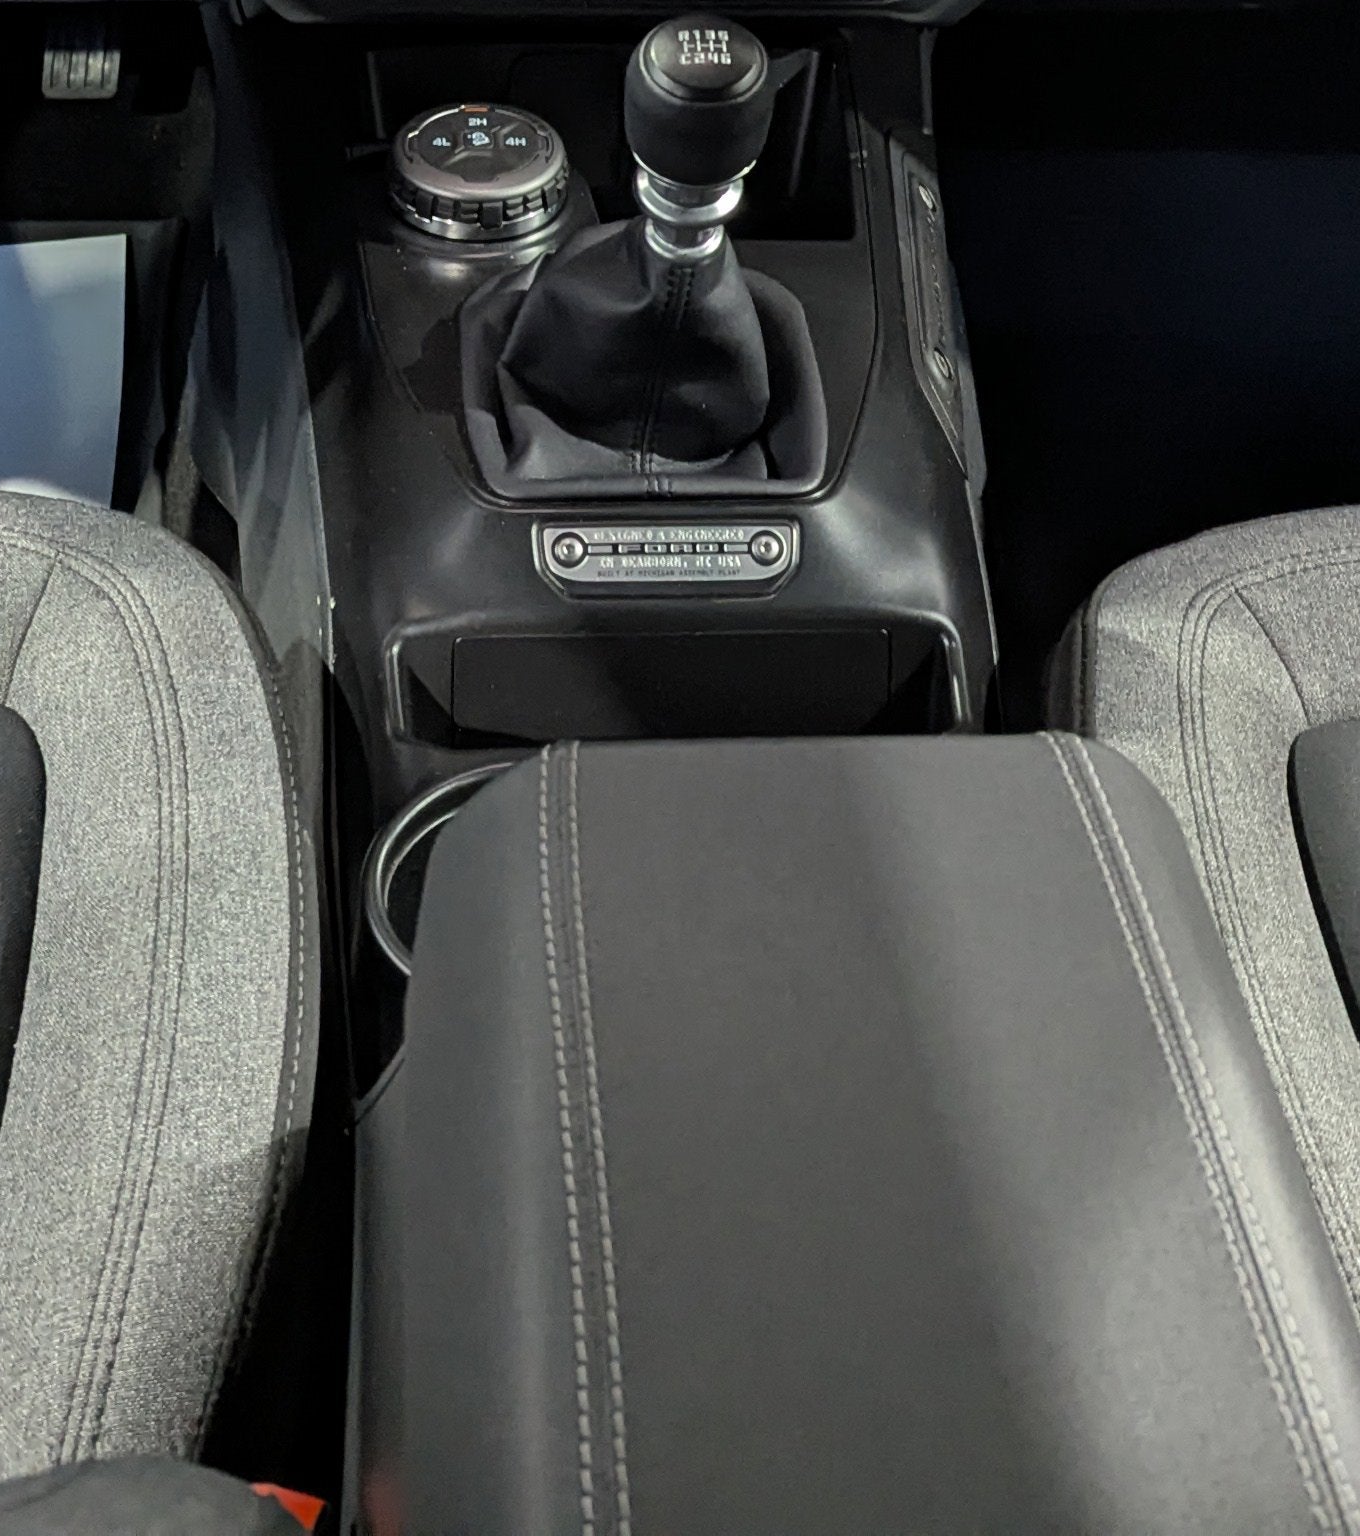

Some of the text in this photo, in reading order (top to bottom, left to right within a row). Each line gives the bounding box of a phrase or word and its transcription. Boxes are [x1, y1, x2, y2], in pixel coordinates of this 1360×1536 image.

[708, 52, 718, 64] 4
[468, 117, 487, 127] 2H
[432, 136, 451, 147] 4L
[505, 136, 527, 146] 4H
[718, 555, 741, 568] USA
